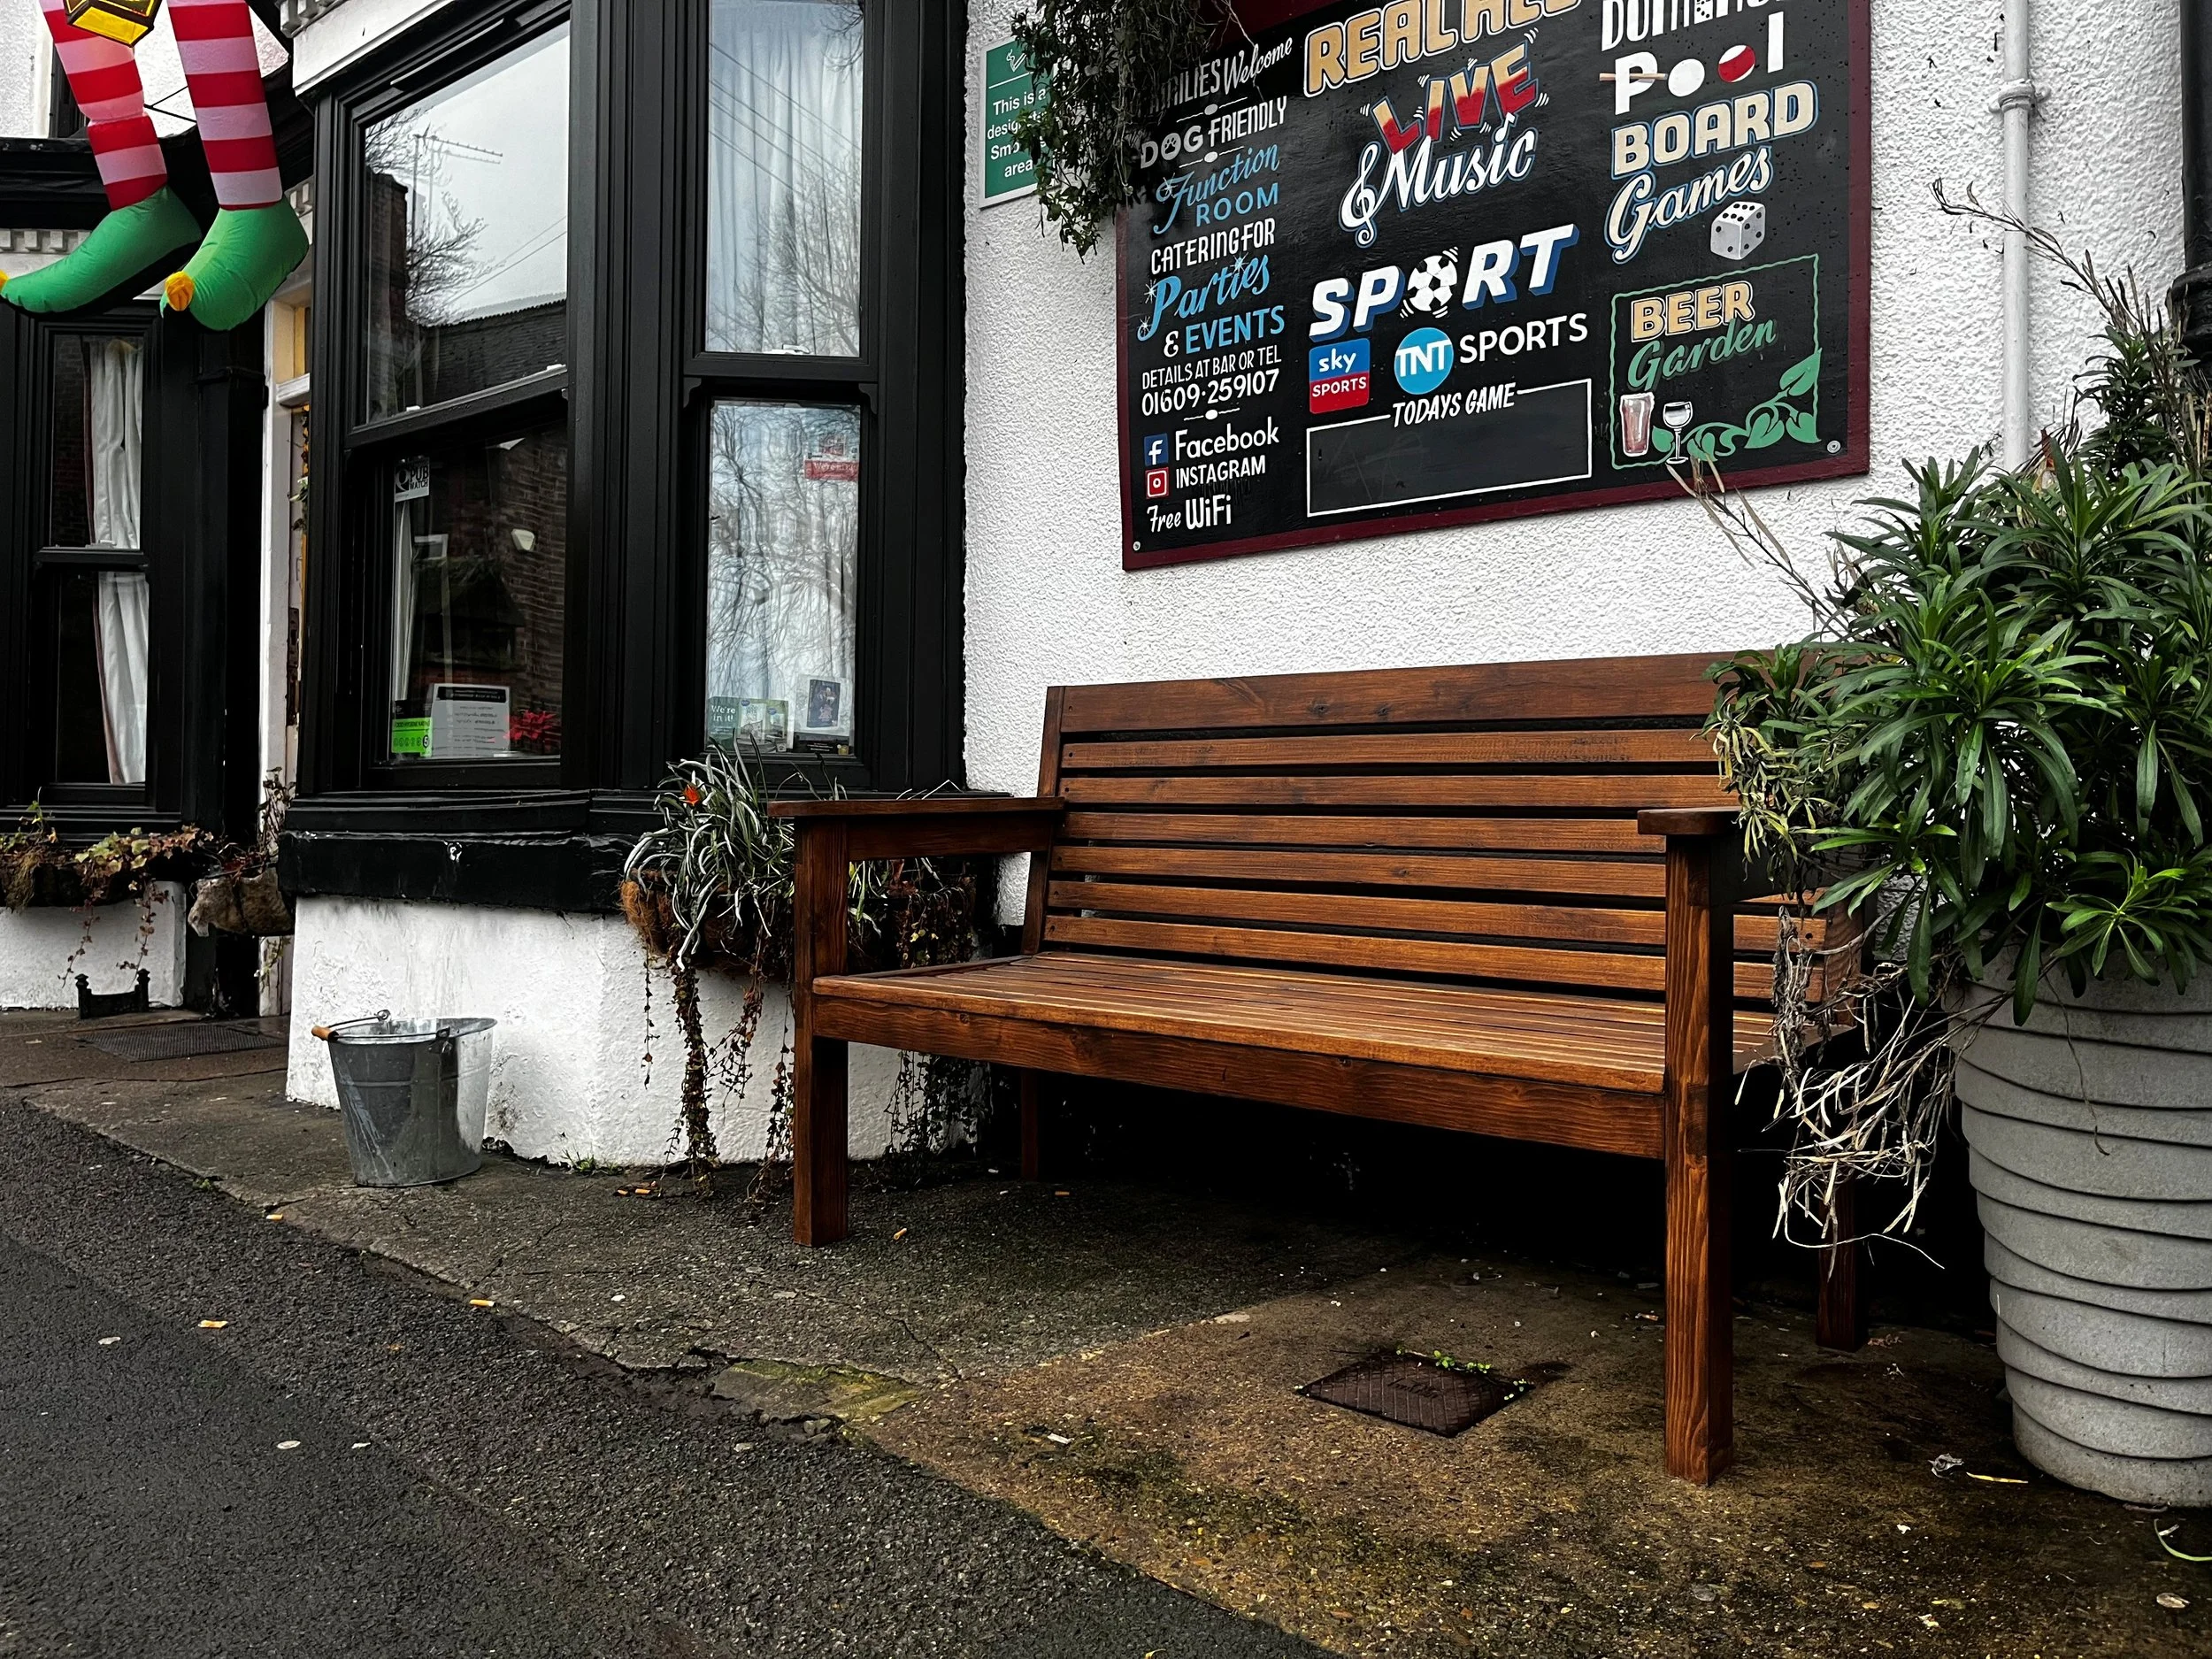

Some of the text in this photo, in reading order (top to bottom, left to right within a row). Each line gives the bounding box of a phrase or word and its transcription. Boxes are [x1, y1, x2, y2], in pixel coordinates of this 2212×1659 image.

[1224, 37, 1293, 95] Welcome
[1303, 0, 1458, 97] REAL
[993, 88, 1046, 115] This is a
[1371, 40, 1540, 156] LIVE
[1141, 96, 1287, 168] DOG FRIENDLY
[1611, 81, 1818, 179] BOARD
[1004, 159, 1033, 177] area
[1153, 144, 1279, 234] Function
[1196, 182, 1279, 227] ROOM
[1604, 145, 1773, 264] Games
[1151, 218, 1276, 274] CATERING FOR
[1137, 255, 1270, 342] Parties
[1632, 280, 1755, 342] BEER
[1164, 305, 1285, 357] & EVENTS
[1395, 312, 1588, 377] TNT SPORTS
[1627, 319, 1777, 391] Garden
[1142, 345, 1282, 389] DETAILS AT BAR OR TEL
[1312, 376, 1367, 397] SPORTS
[1318, 348, 1356, 373] sky
[1393, 382, 1517, 427] TODAYS GAME
[1175, 416, 1279, 461] Facebook
[410, 465, 428, 482] PUB
[1176, 454, 1266, 488] INSTAGRAM
[1147, 494, 1232, 533] Free WiFi
